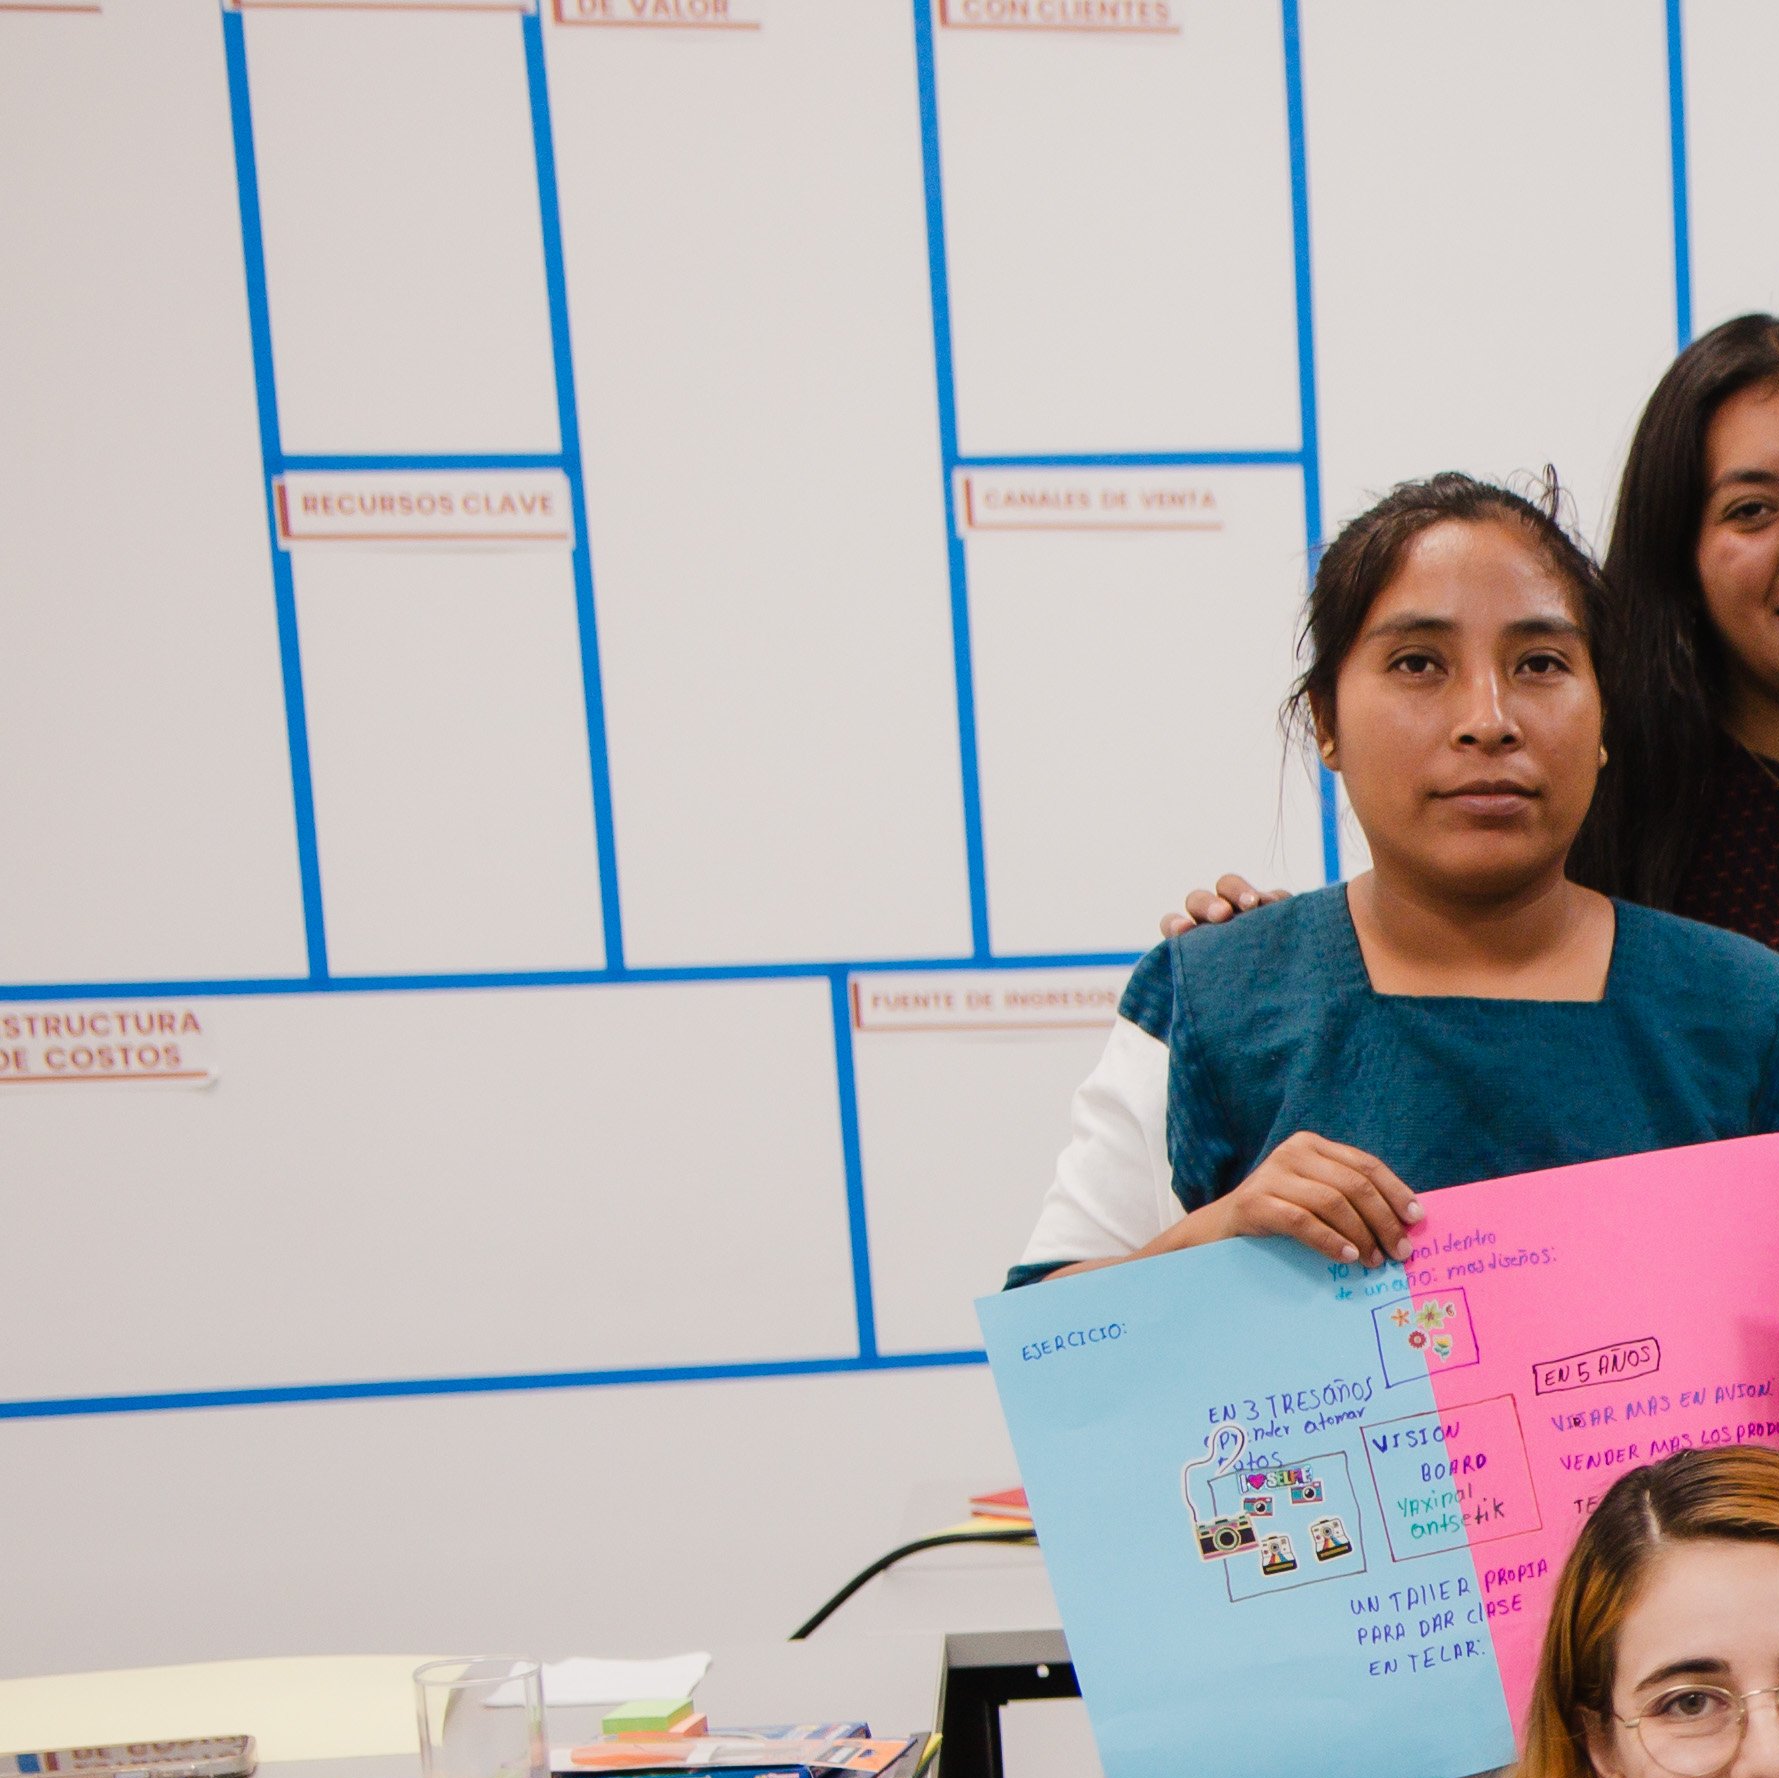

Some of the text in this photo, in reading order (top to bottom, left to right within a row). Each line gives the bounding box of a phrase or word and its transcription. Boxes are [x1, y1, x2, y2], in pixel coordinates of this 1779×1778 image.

[301, 493, 553, 517] RECURSOS CLAVE
[983, 489, 1217, 511] CANALES DE VENTA
[869, 988, 1118, 1013] FUENTE DE INGRESOS
[0, 1010, 201, 1040] STRUCTURA
[44, 1042, 181, 1070] COSTOS
[1021, 1321, 1129, 1362] EJERCICIO:
[1544, 1346, 1652, 1388] EN 5 AÑOS
[1206, 1397, 1260, 1426] EN 3
[1623, 1386, 1707, 1420] MAS EN
[1371, 1423, 1460, 1456] VISION
[1558, 1442, 1641, 1474] VENDER
[1647, 1431, 1694, 1456] MAS
[1698, 1424, 1731, 1446] LOS
[1419, 1451, 1489, 1484] BOARD
[1349, 1557, 1551, 1617] UN PROPIA
[1355, 1610, 1456, 1647] PARA DAR
[1368, 1639, 1487, 1677] EN TELAR:
